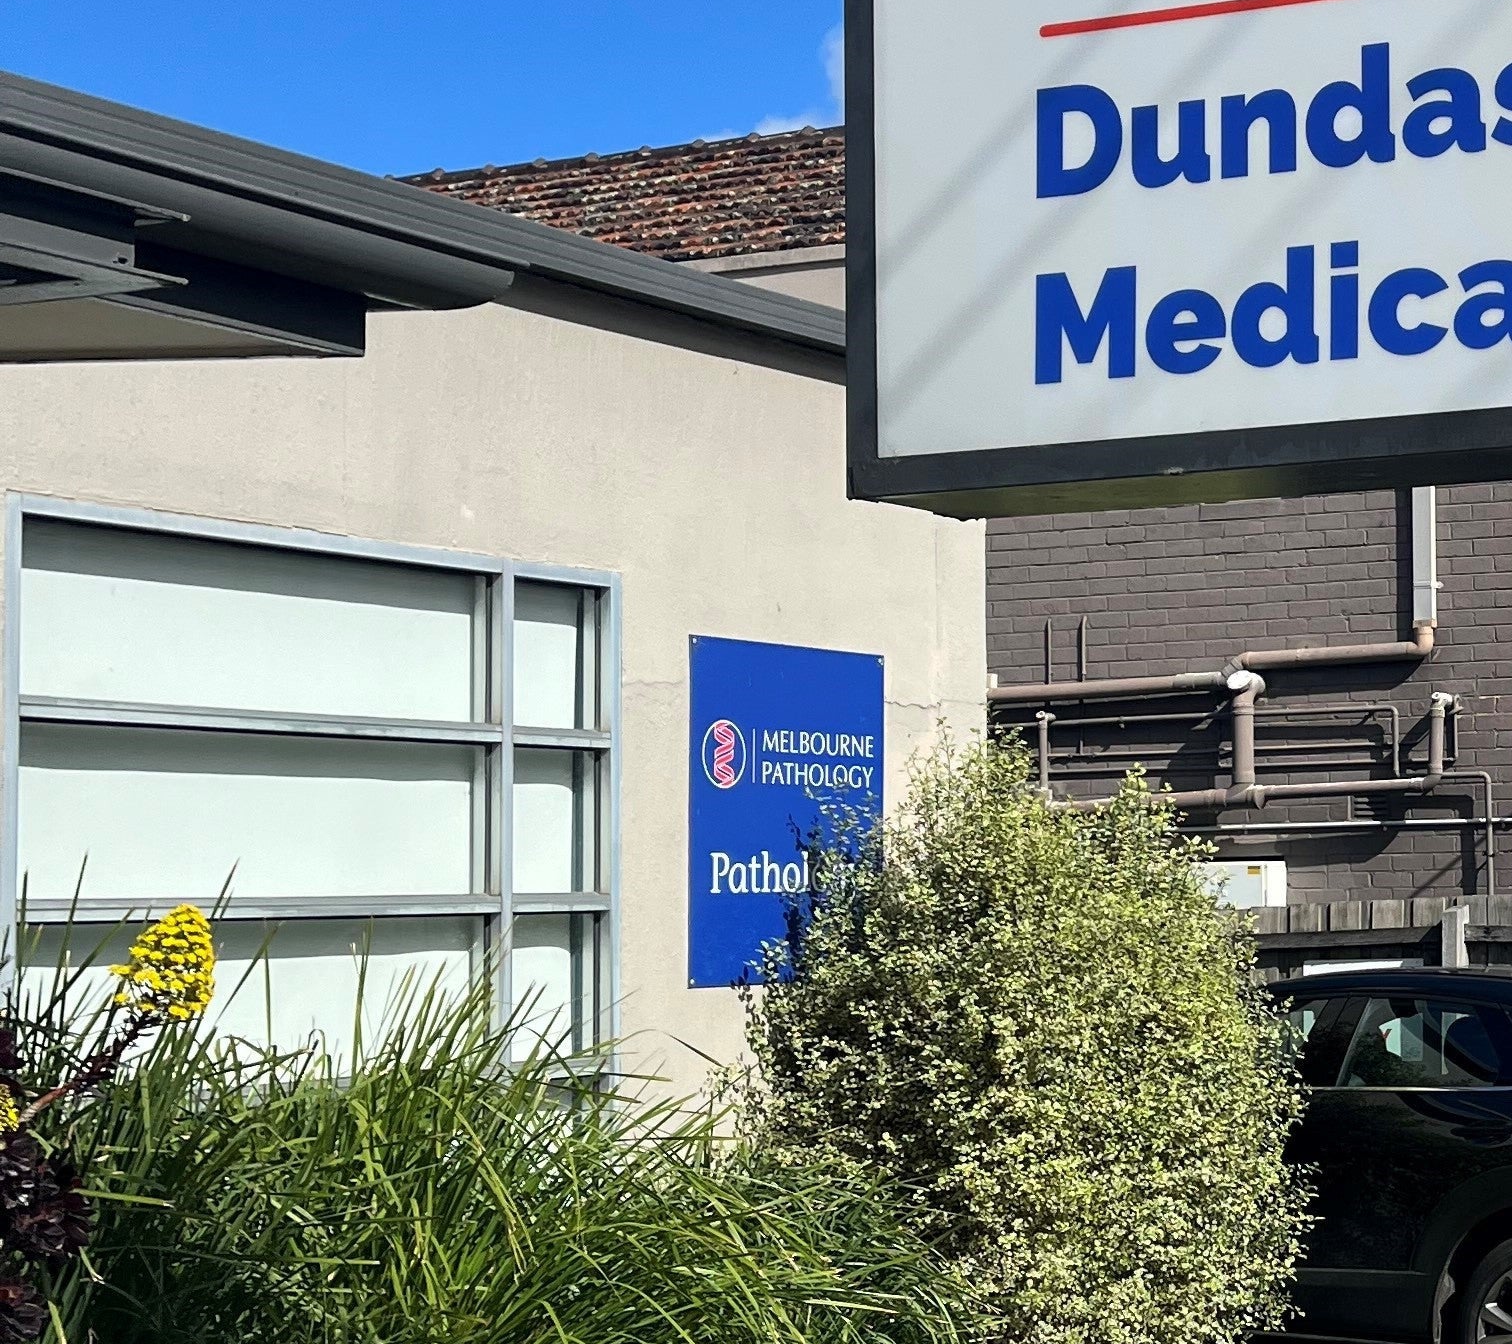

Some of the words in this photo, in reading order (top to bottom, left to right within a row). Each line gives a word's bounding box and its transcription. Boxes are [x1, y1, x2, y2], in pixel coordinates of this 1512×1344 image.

[762, 729, 874, 758] MELBOURNE
[762, 761, 874, 789] PATHOLOGY
[709, 850, 832, 894] Pathol
